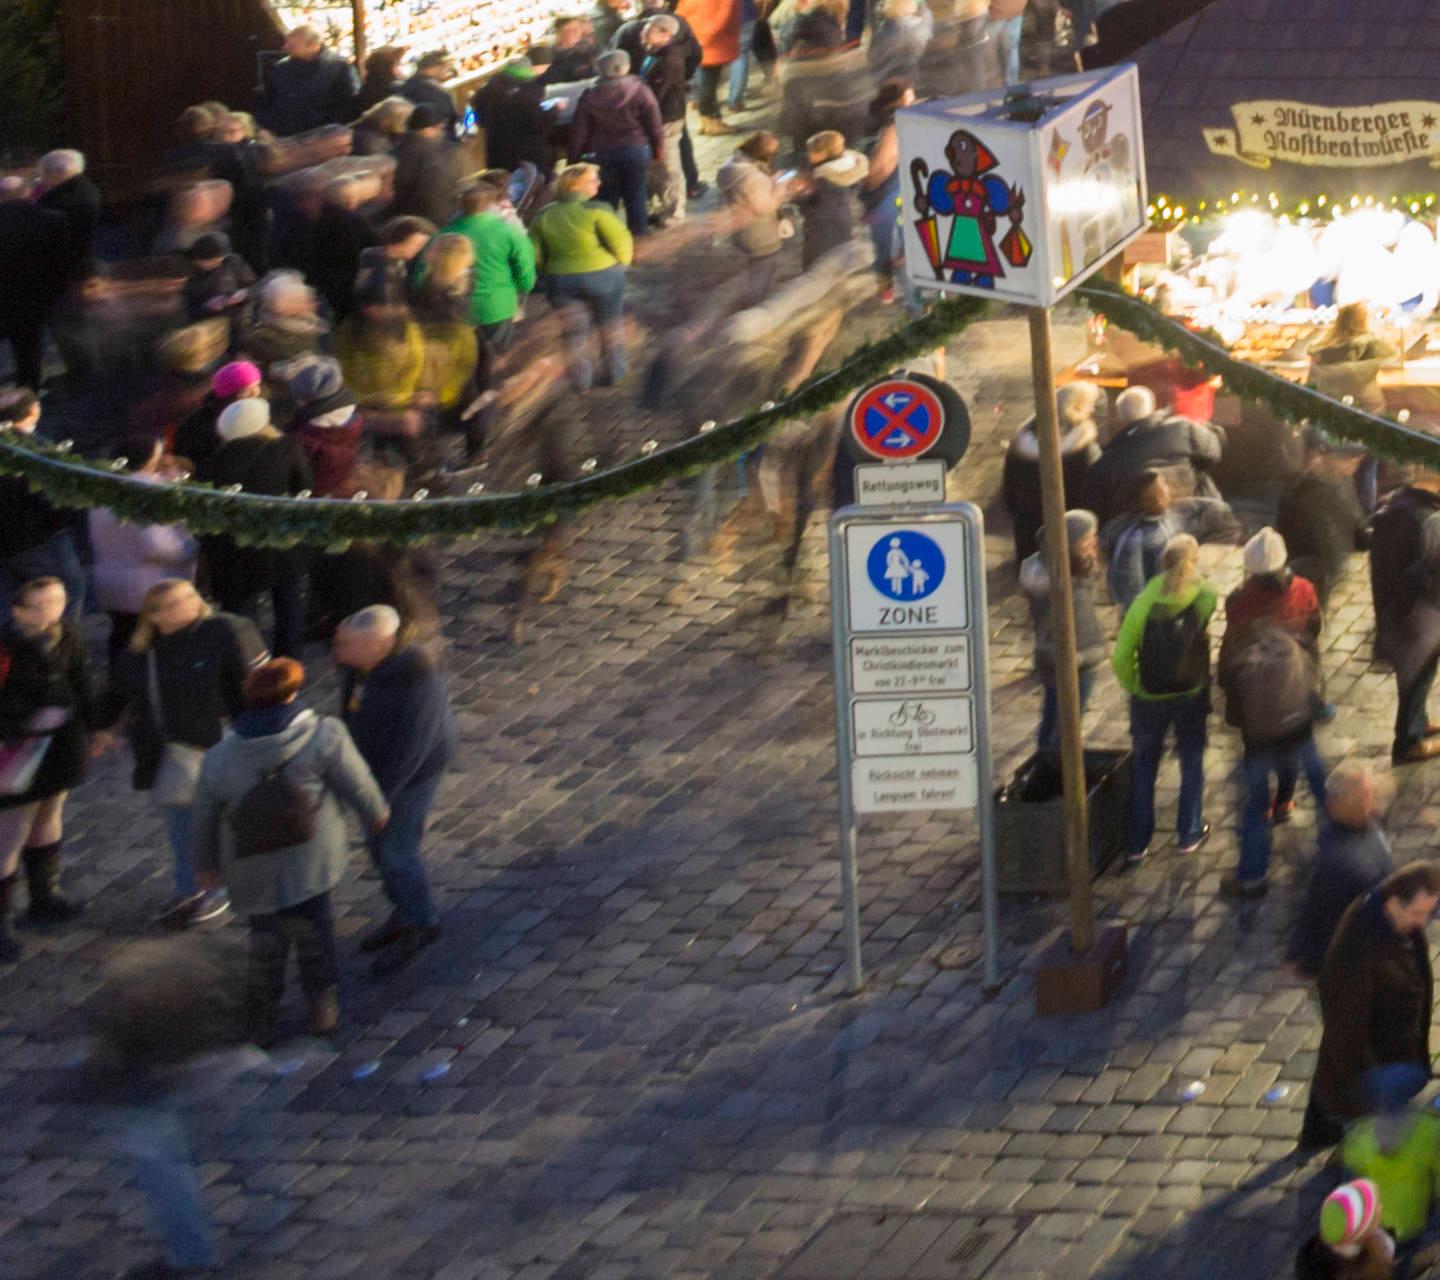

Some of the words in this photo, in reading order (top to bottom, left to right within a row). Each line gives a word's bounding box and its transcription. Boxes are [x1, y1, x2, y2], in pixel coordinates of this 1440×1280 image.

[1273, 106, 1412, 136] Nürnberger
[862, 478, 940, 494] Rettungsweg
[878, 605, 939, 626] ZONE
[943, 643, 965, 653] zum
[862, 657, 959, 671] Christkindlesmarkt
[871, 727, 914, 741] Richtung
[868, 768, 917, 782] Rücksicht
